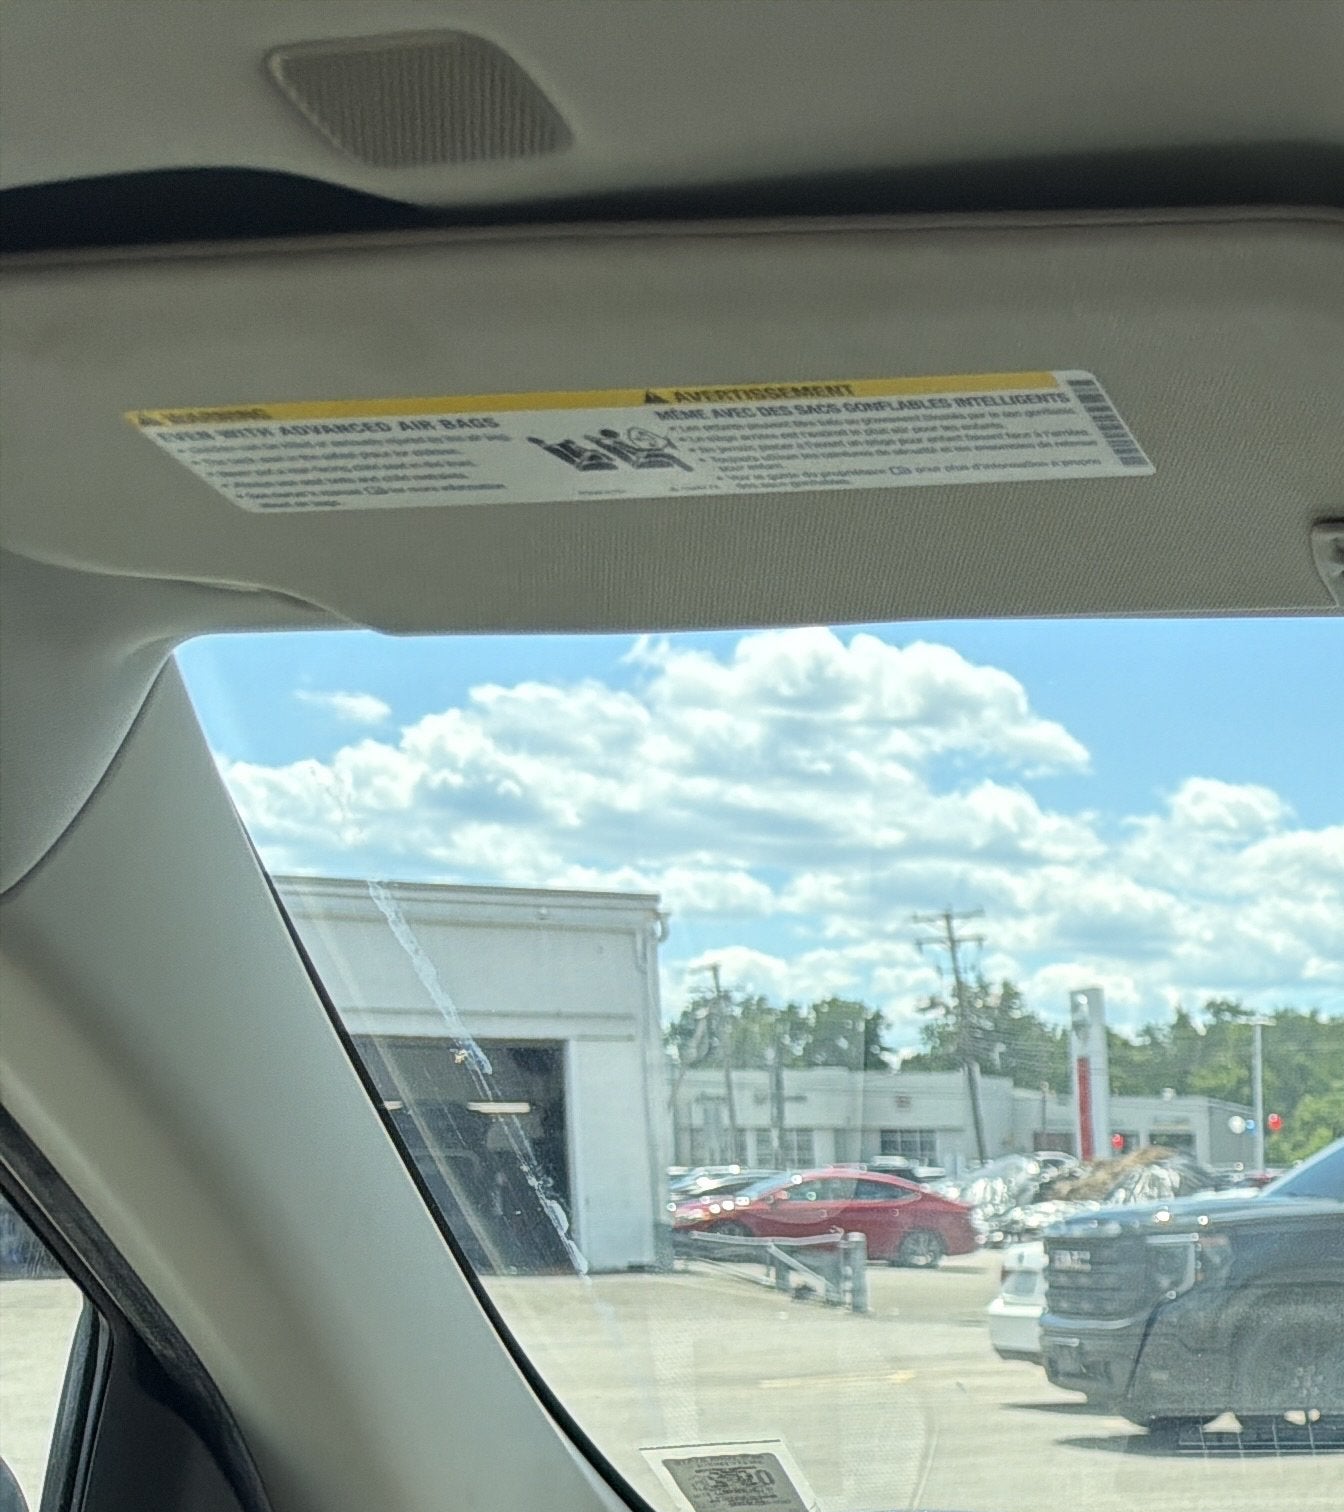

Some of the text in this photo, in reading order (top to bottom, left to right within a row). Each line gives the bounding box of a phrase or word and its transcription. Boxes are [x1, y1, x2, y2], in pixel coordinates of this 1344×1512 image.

[672, 384, 856, 403] AVERTISSEMENT
[710, 406, 756, 419] AVEC
[756, 405, 794, 417] DES
[793, 403, 841, 415] SACS
[841, 398, 953, 413] GONFLABLES
[953, 392, 1070, 408] INTELLIGENTS
[215, 426, 275, 439] WITH
[277, 421, 393, 436] ADVANCED
[398, 419, 437, 432] AIR
[437, 417, 501, 430] BAGS
